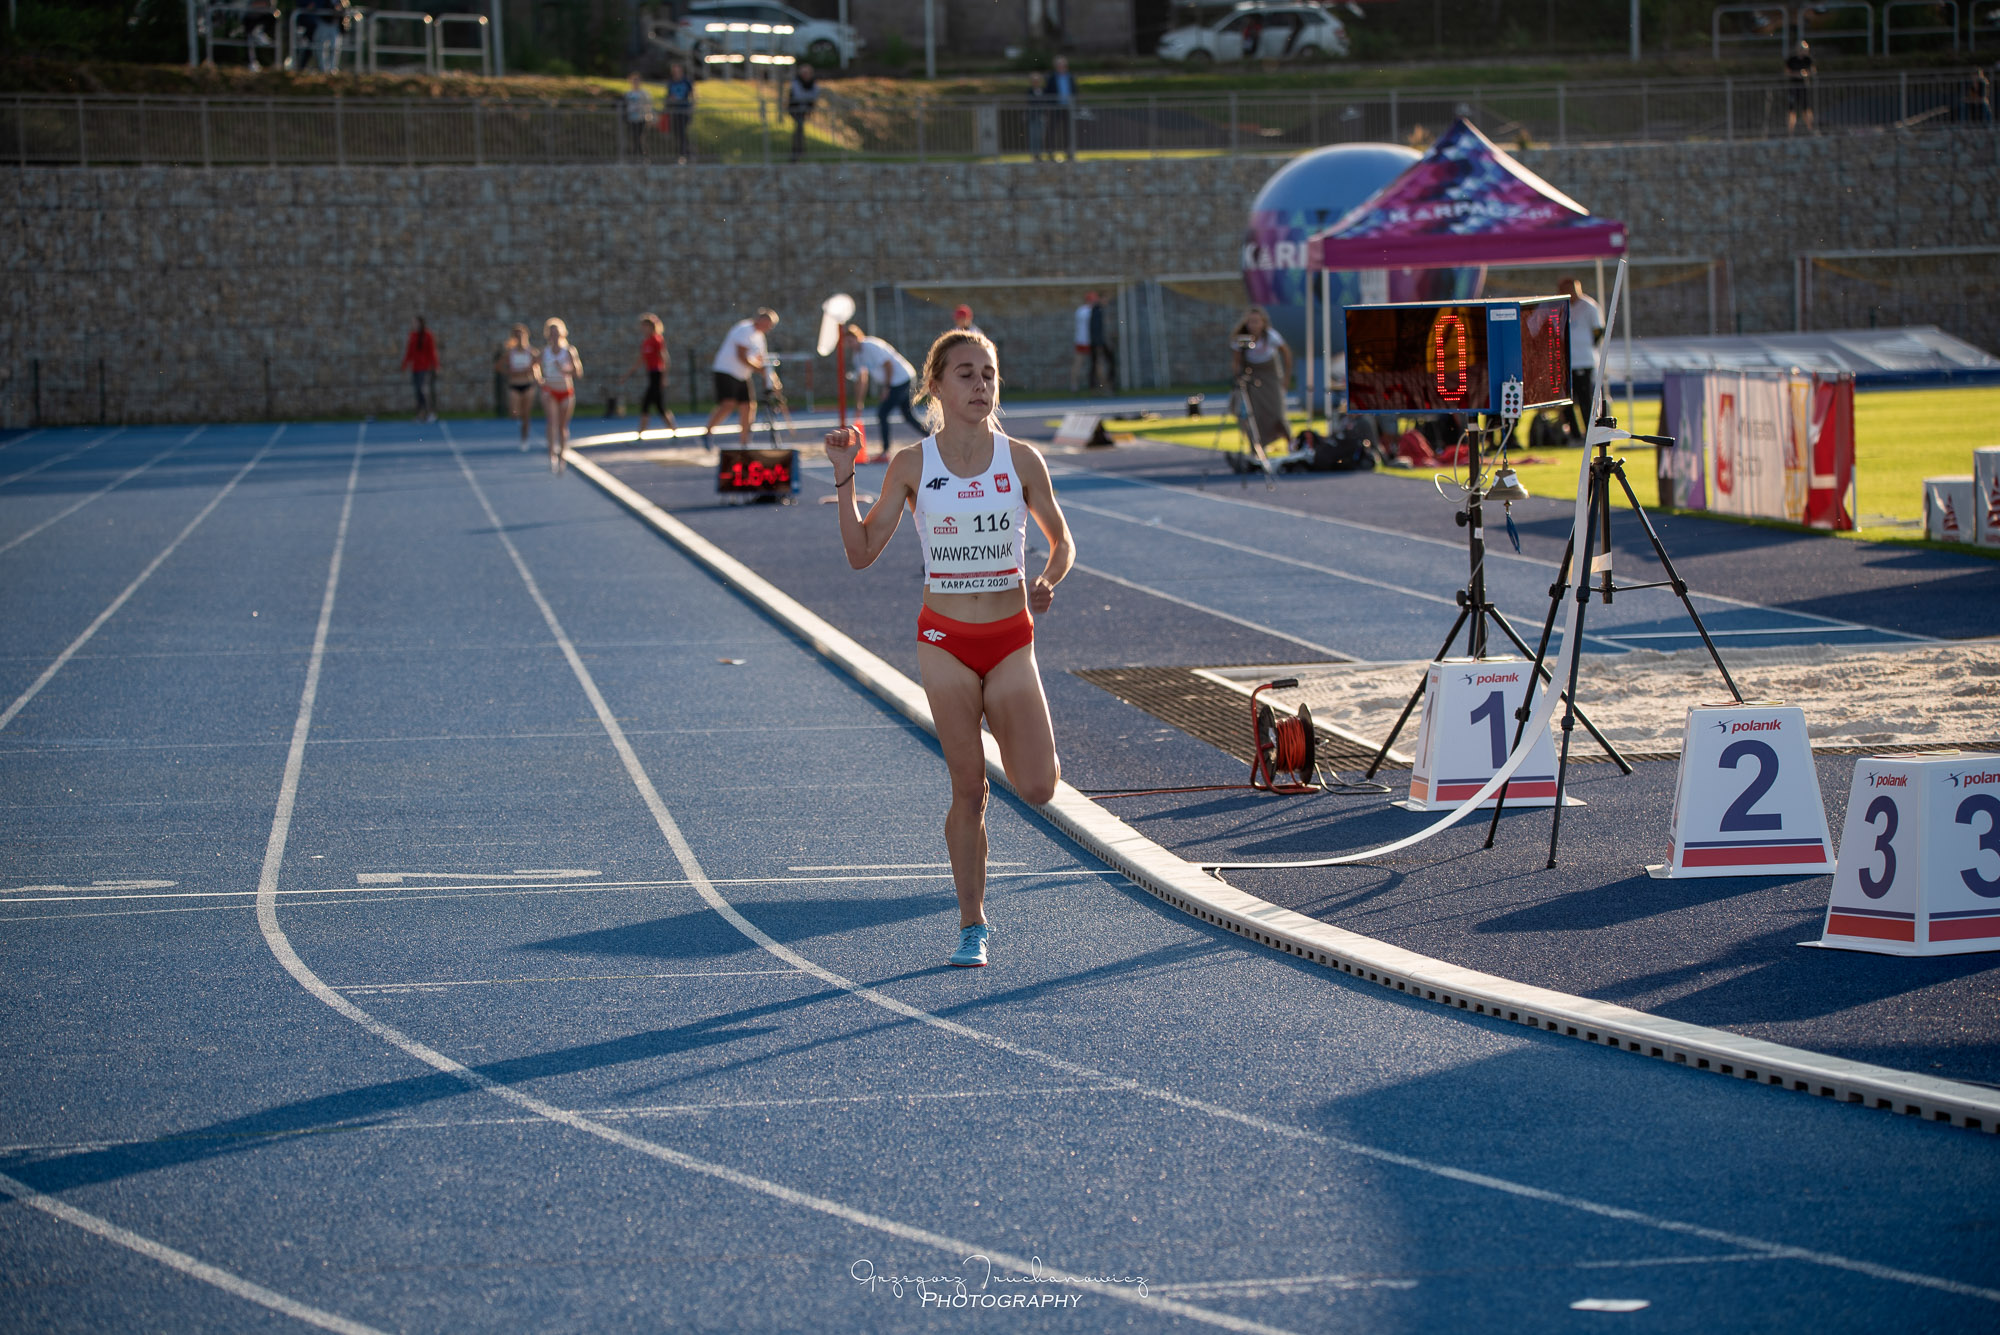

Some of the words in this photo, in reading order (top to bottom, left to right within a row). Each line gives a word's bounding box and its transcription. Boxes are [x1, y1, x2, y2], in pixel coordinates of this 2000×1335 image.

[1435, 315, 1467, 401] 0
[973, 512, 1010, 533] 116
[930, 542, 1012, 561] WAWRZYNIAK
[941, 579, 984, 589] KARPACZ
[987, 577, 1008, 587] 2020
[1476, 672, 1519, 686] polanik
[1470, 691, 1507, 769] 1
[1731, 719, 1782, 734] polanik
[1718, 740, 1782, 832] 2
[1876, 773, 1908, 788] polanik
[1859, 795, 1899, 899] 3
[1955, 794, 2000, 898] 3
